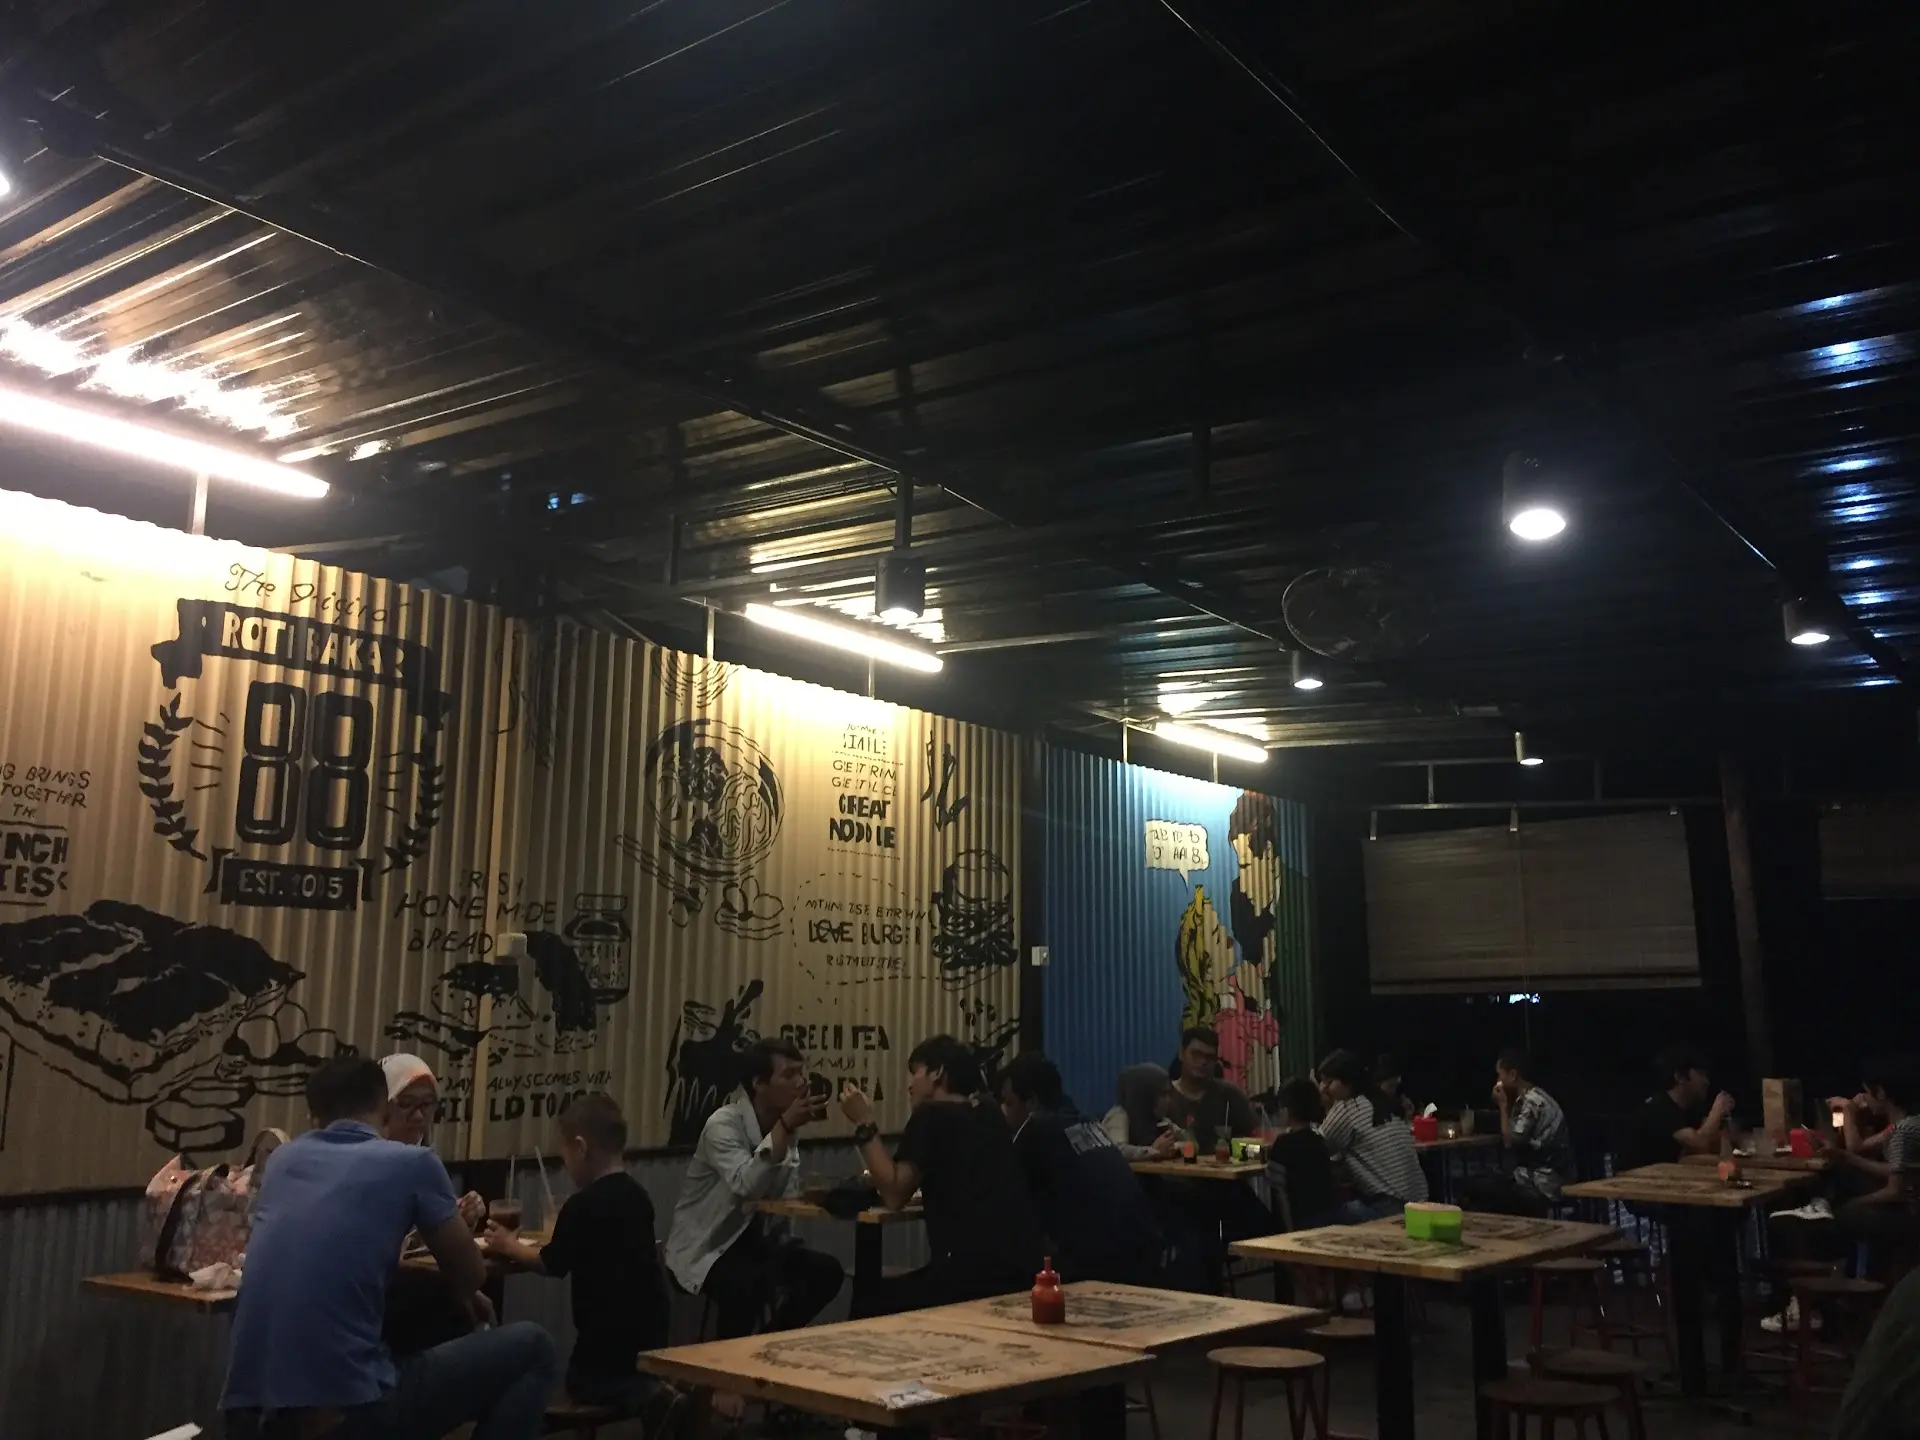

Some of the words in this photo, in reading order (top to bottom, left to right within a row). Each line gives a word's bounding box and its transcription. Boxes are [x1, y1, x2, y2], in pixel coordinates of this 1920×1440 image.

[224, 562, 277, 598] The
[221, 611, 295, 660] ROTI
[305, 626, 405, 679] BAKAR
[235, 679, 374, 850] 88
[238, 868, 284, 898] EST.
[496, 900, 557, 924] MDE
